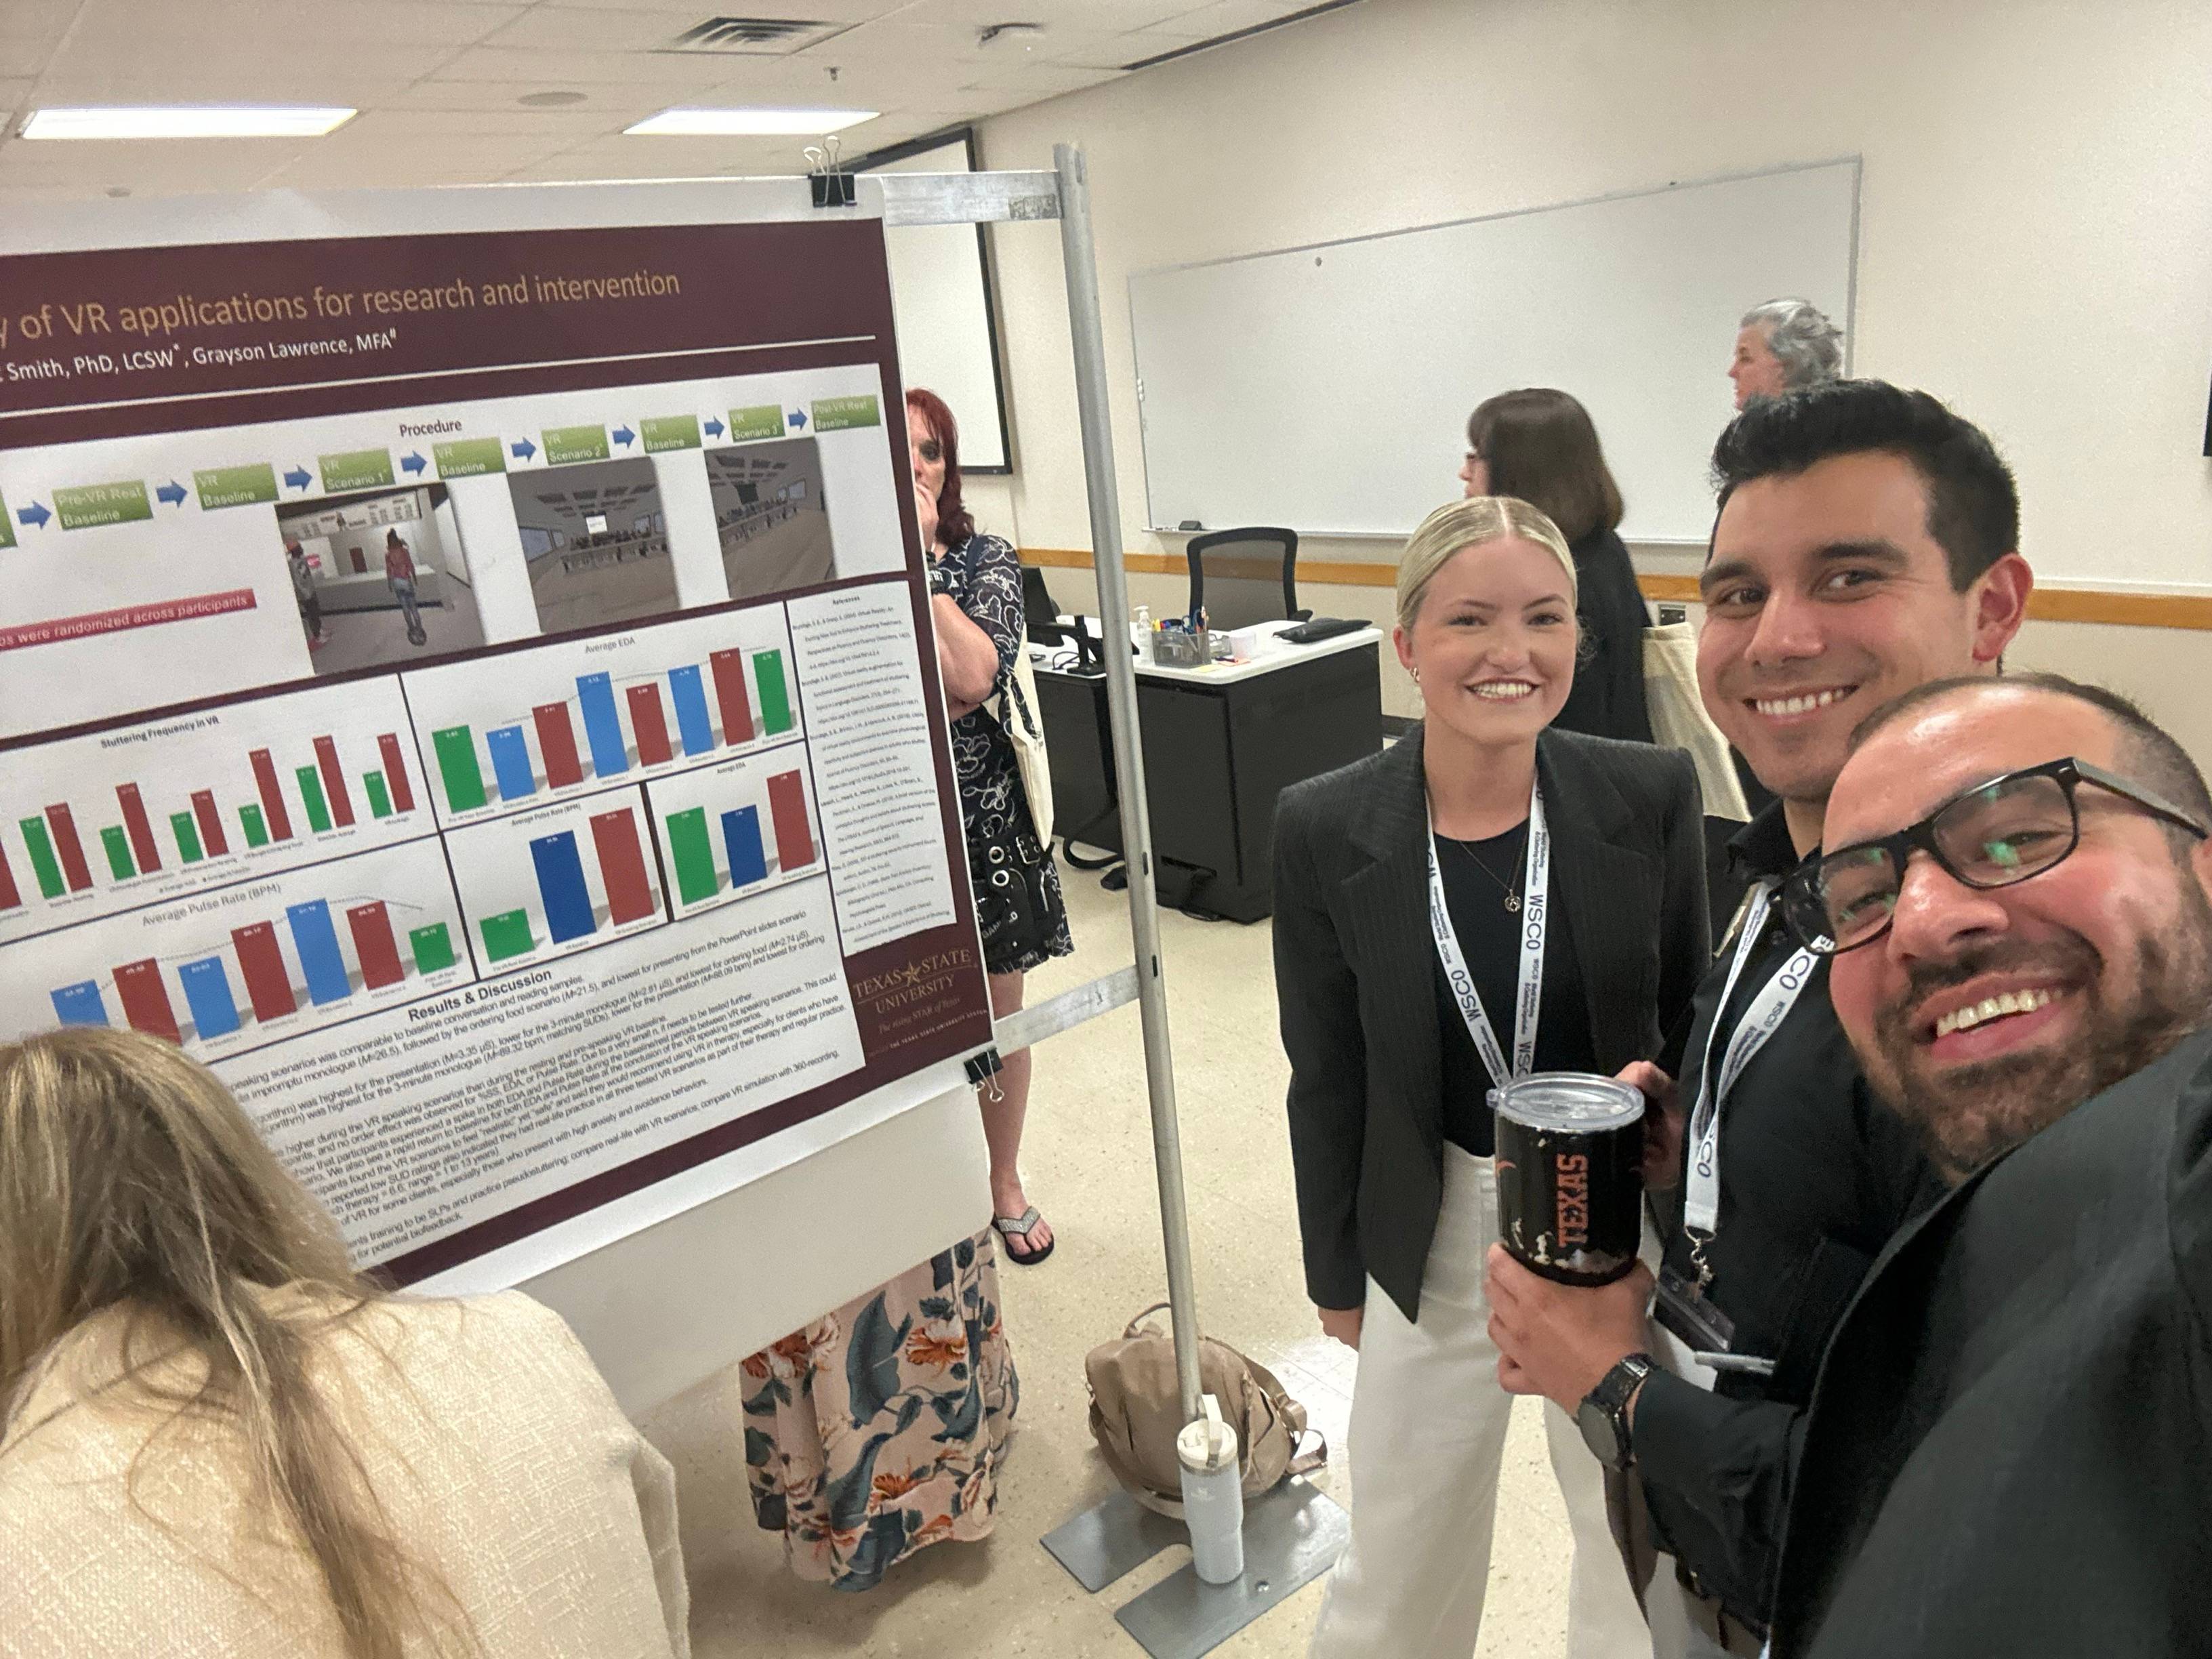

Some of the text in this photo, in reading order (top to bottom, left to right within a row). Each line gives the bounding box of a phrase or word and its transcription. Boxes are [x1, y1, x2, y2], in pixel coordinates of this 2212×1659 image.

[20, 304, 52, 339] of
[60, 303, 111, 335] VR
[119, 293, 308, 337] applications
[313, 285, 353, 316] for
[363, 278, 474, 314] research
[483, 275, 529, 306] and
[535, 270, 680, 303] intervention
[7, 359, 70, 380] Smith,
[75, 354, 119, 375] PhD,
[192, 344, 265, 366] Grayson
[269, 337, 354, 359] Lawrence,
[399, 419, 462, 437] Procedure
[644, 424, 657, 434] VR
[731, 414, 745, 423] VR
[734, 427, 771, 439] Scenario
[815, 418, 848, 430] Baseline
[436, 447, 453, 458] VR
[546, 434, 561, 444] VR
[647, 439, 684, 451] Baseline
[441, 462, 486, 476] Baseline
[549, 449, 592, 462] Scenario
[57, 488, 106, 506] Pre-VR
[197, 476, 218, 487] VR
[325, 476, 375, 490] Scenario
[203, 491, 255, 506] Baseline
[63, 510, 120, 527] Baseline
[18, 630, 50, 643] were
[54, 614, 129, 636] randomized
[134, 609, 174, 623] across
[178, 596, 247, 619] participants
[585, 637, 636, 654] Average EDA
[101, 716, 220, 748] Stuttering Frequency in VR
[143, 907, 187, 926] Average
[189, 899, 220, 914] Pulse
[220, 892, 247, 907] Rate
[248, 884, 281, 901] (BPM)
[1526, 894, 1544, 950] WSCO
[853, 949, 971, 998] TEXAS STATE
[1779, 954, 1810, 991] CO
[251, 1077, 303, 1099] impromptu
[304, 1060, 356, 1082] monologue
[403, 1032, 441, 1052] followed
[440, 1030, 452, 1040] by
[453, 1025, 468, 1036] the
[469, 1013, 506, 1031] ordering
[505, 1006, 525, 1019] food
[526, 996, 561, 1013] scenario
[601, 975, 616, 989] and
[616, 968, 640, 982] lowest
[640, 964, 651, 974] for
[653, 951, 690, 971] presenting
[690, 945, 707, 956] from
[706, 941, 718, 951] the
[718, 926, 758, 945] PowerPoint
[758, 920, 778, 933] slides
[778, 911, 806, 926] scenario
[407, 998, 462, 1021] Results
[464, 991, 476, 1004] &
[477, 970, 552, 1000] Discussion
[876, 974, 954, 1013] UNIVERSITY
[1451, 970, 1482, 1022] WSCO
[228, 975, 583, 1094] peaking scenarios was comparable to baseline conversation and reading samples.
[316, 1156, 335, 1170] that
[336, 1140, 388, 1164] participants
[390, 1119, 444, 1145] experienced
[453, 1109, 476, 1124] spike
[486, 1099, 506, 1111] both
[506, 1090, 526, 1105] EDA
[526, 1083, 542, 1097] and
[542, 1076, 565, 1090] Pulse
[565, 1068, 585, 1081] Rate
[586, 1059, 610, 1073] during
[609, 1053, 623, 1063] the
[670, 1025, 697, 1043] periods
[697, 1015, 727, 1030] between
[726, 1008, 739, 1019] VR
[739, 998, 771, 1015] speaking
[771, 986, 802, 1003] scenarios.
[803, 980, 819, 990] This
[819, 972, 837, 985] could
[1515, 1041, 1532, 1077] WSC
[369, 1222, 404, 1241] training
[452, 1195, 469, 1209] and
[469, 1183, 502, 1203] practice
[570, 1141, 605, 1160] compare
[605, 1130, 633, 1146] real-life
[634, 1123, 650, 1135] with
[649, 1116, 663, 1128] VR
[700, 1091, 731, 1109] compare
[730, 1085, 743, 1097] VR
[743, 1073, 778, 1091] simulation
[778, 1066, 794, 1078] with
[1557, 1153, 1589, 1248] TEXAS
